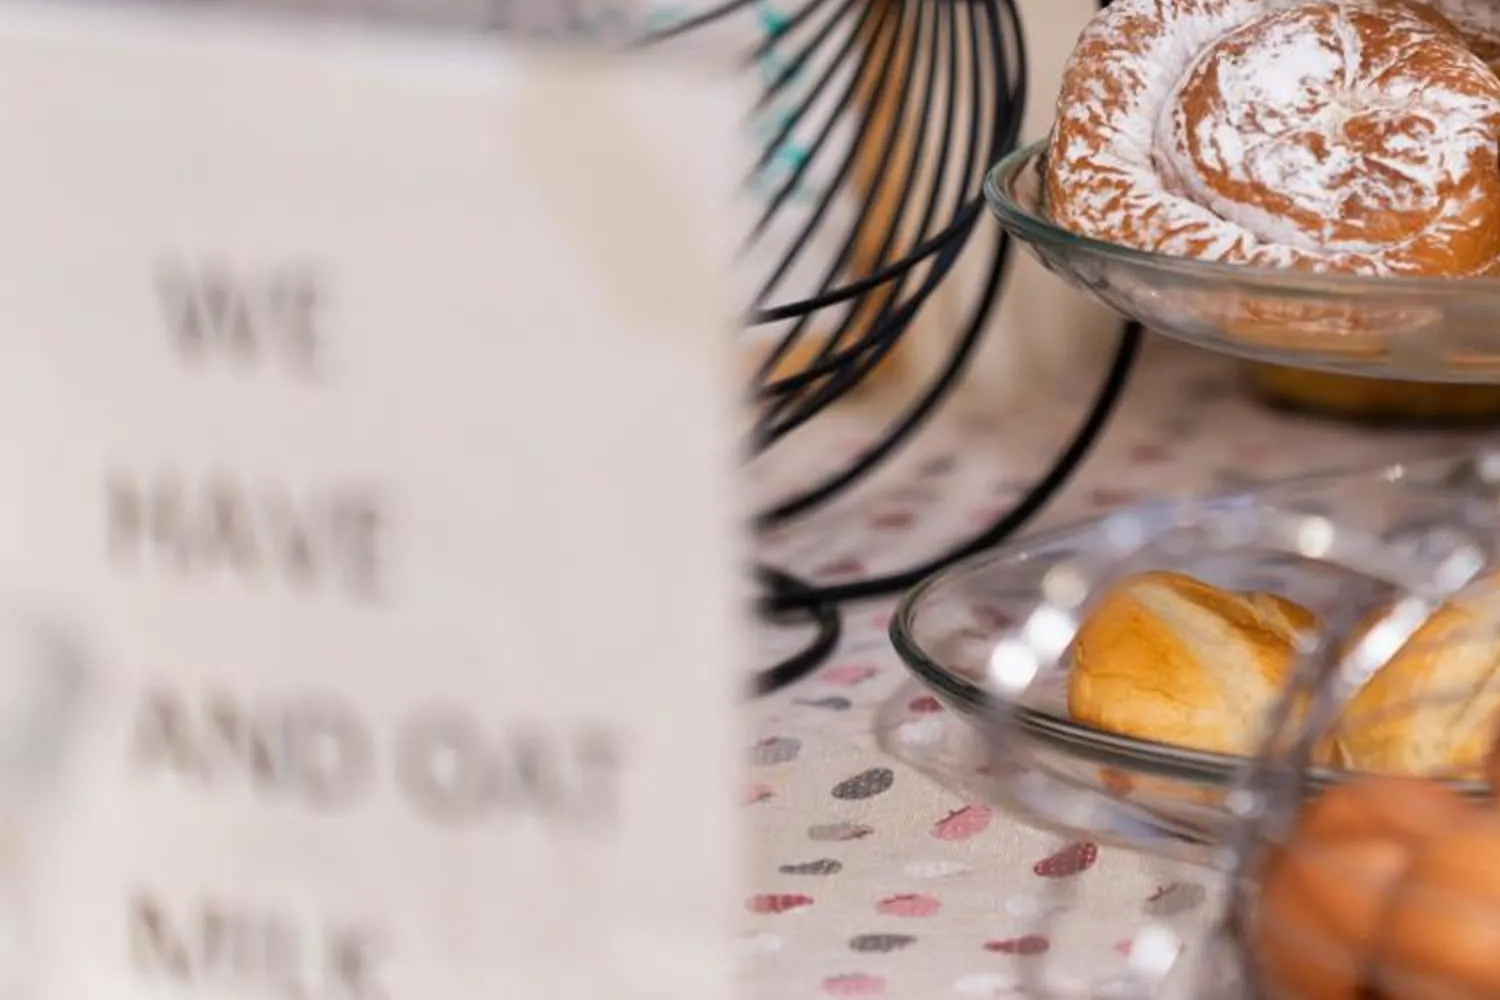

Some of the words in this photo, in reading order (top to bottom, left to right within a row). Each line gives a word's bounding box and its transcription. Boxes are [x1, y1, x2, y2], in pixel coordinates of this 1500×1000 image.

[155, 255, 332, 378] WE
[103, 466, 388, 602] HAVE
[127, 683, 374, 810] AND
[395, 698, 622, 832] OAT
